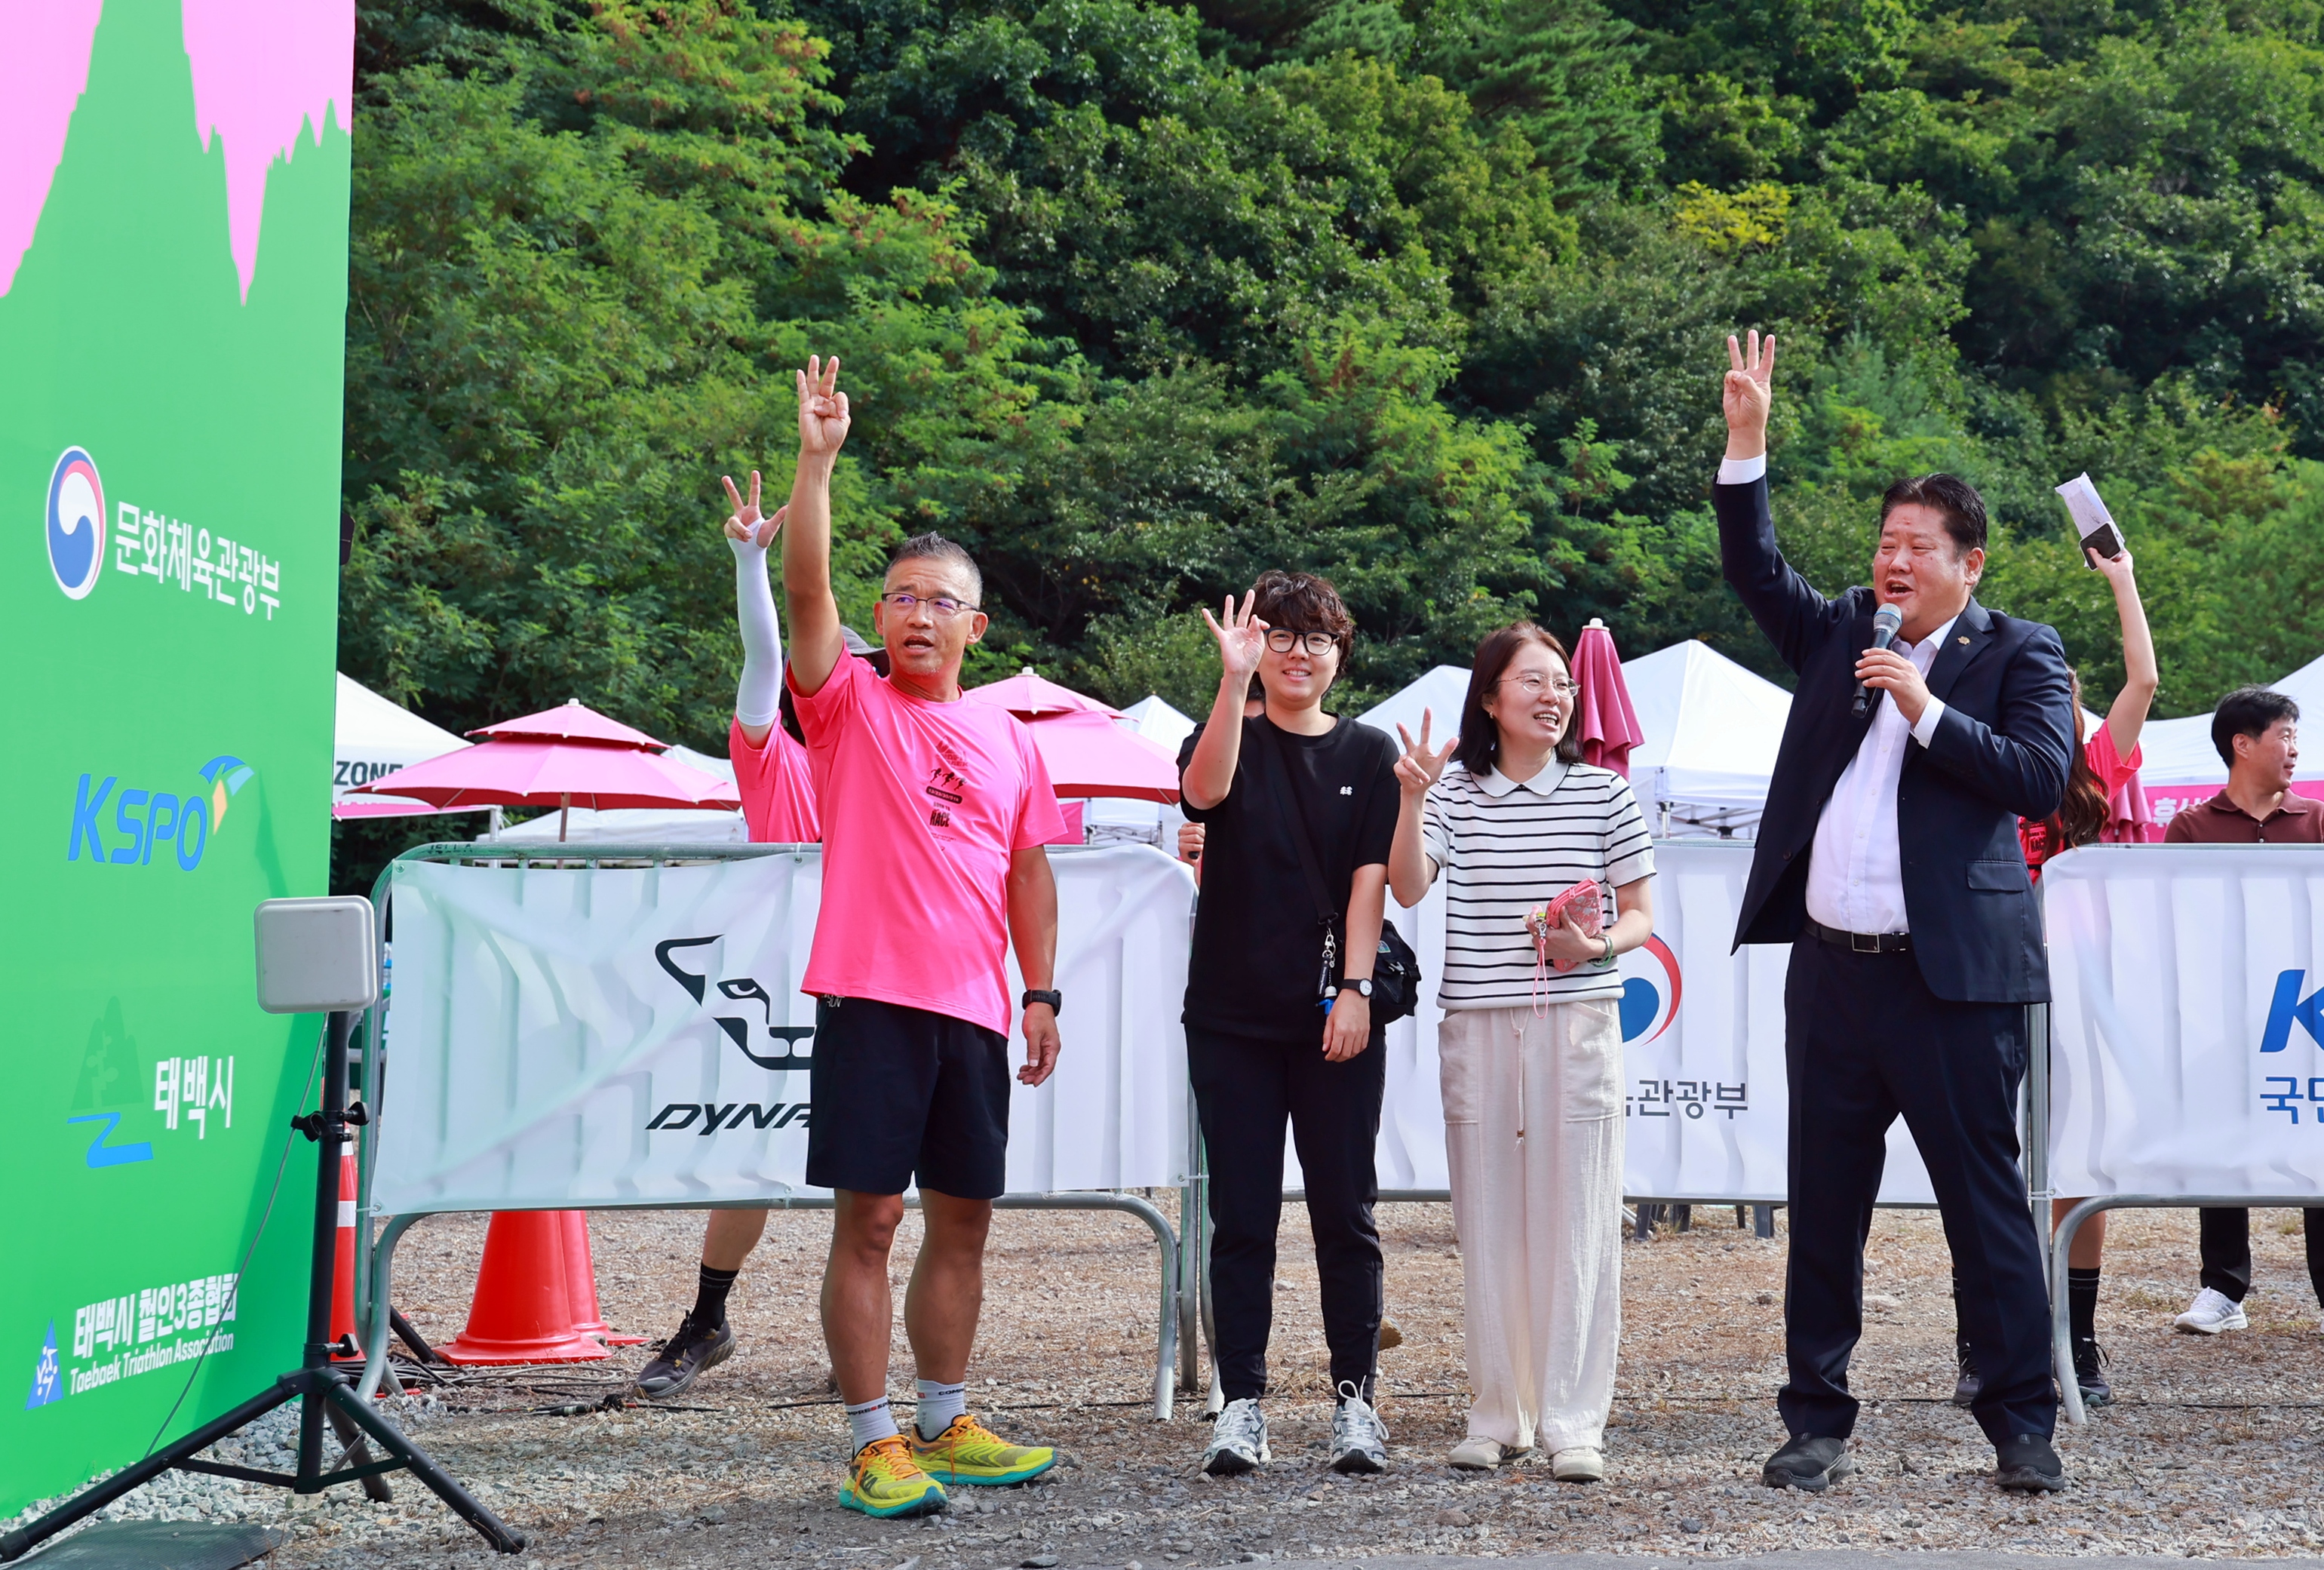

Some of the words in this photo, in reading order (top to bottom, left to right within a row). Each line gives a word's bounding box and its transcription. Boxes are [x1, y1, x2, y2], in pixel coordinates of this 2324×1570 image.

[115, 501, 280, 621] 문화체육관광부
[68, 773, 207, 872] KSPO
[154, 1055, 234, 1139] 태백시
[73, 1293, 136, 1359] 태백시
[138, 1273, 239, 1344] 철인3종협회
[70, 1354, 121, 1395] Taebaek
[123, 1341, 173, 1378] Triathlon
